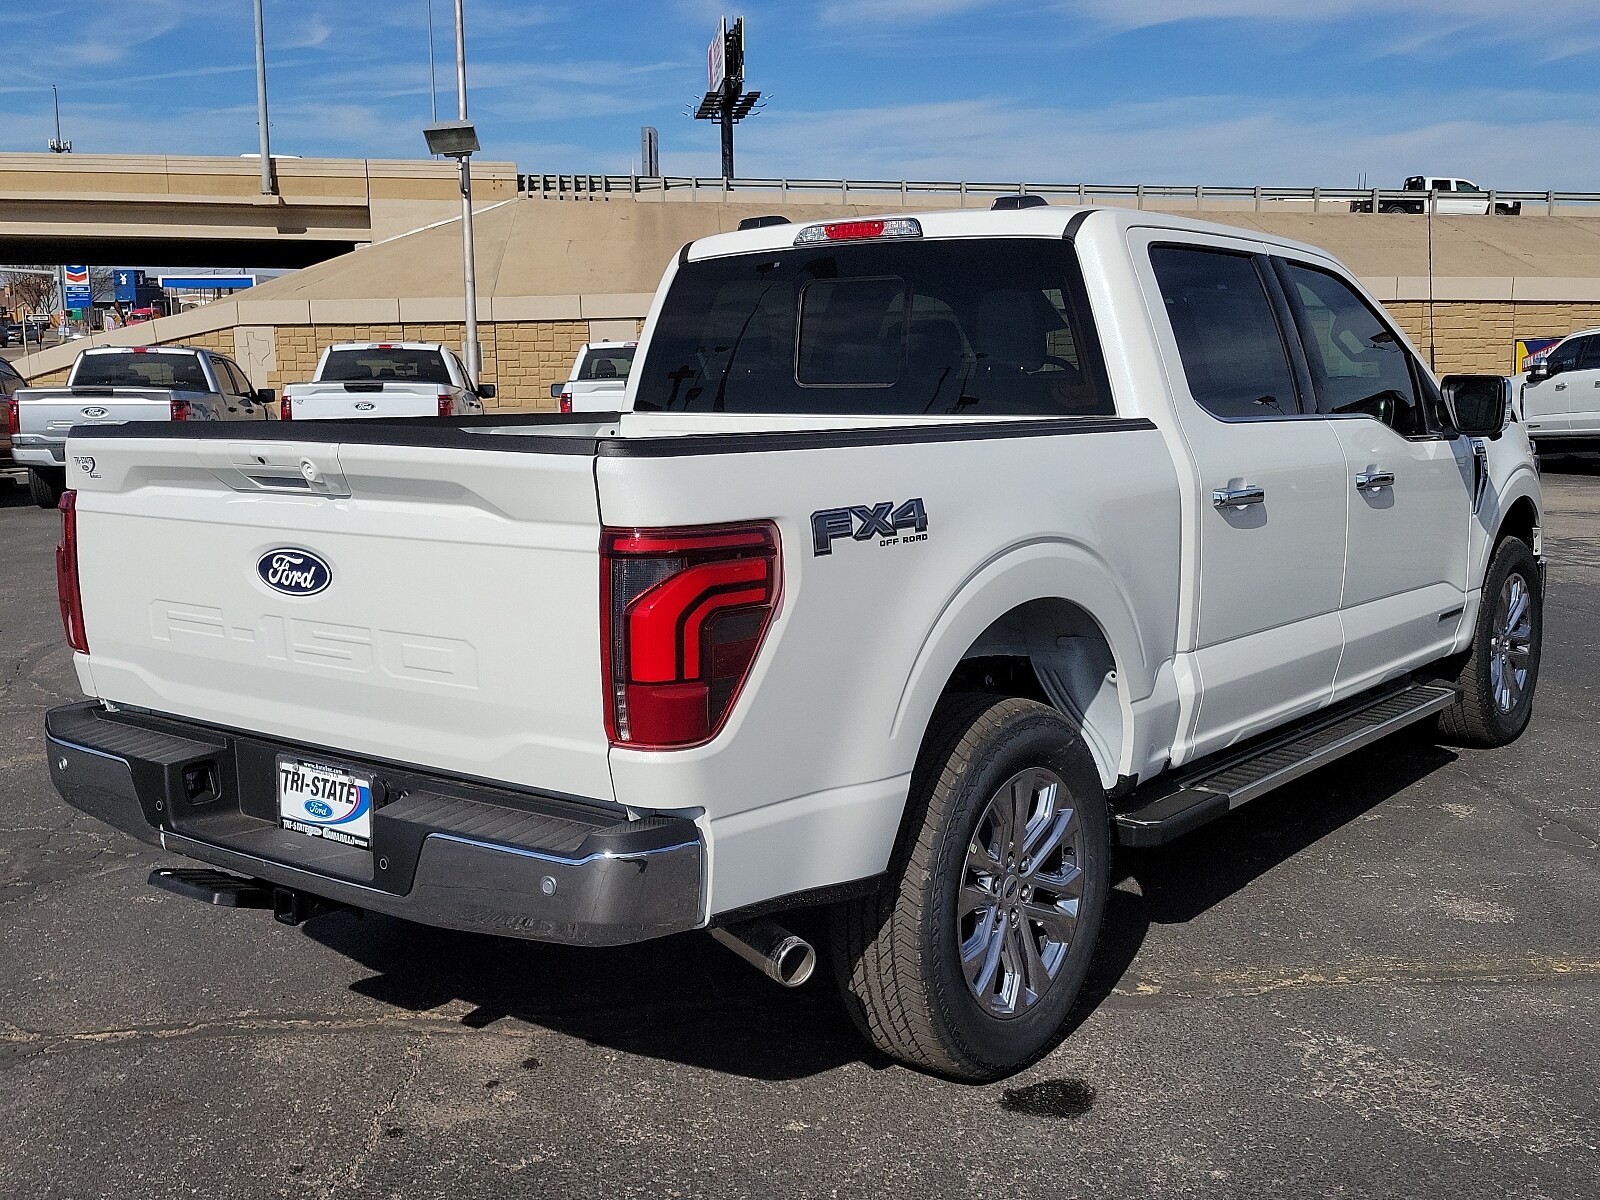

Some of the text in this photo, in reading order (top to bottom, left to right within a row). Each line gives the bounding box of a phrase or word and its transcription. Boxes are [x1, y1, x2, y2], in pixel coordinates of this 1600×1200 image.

[810, 497, 928, 557] FX4
[879, 534, 928, 547] OFF ROAD
[268, 554, 316, 589] Ford
[149, 598, 480, 690] F-150
[280, 769, 357, 805] TRI-STATE
[309, 801, 328, 816] Ford
